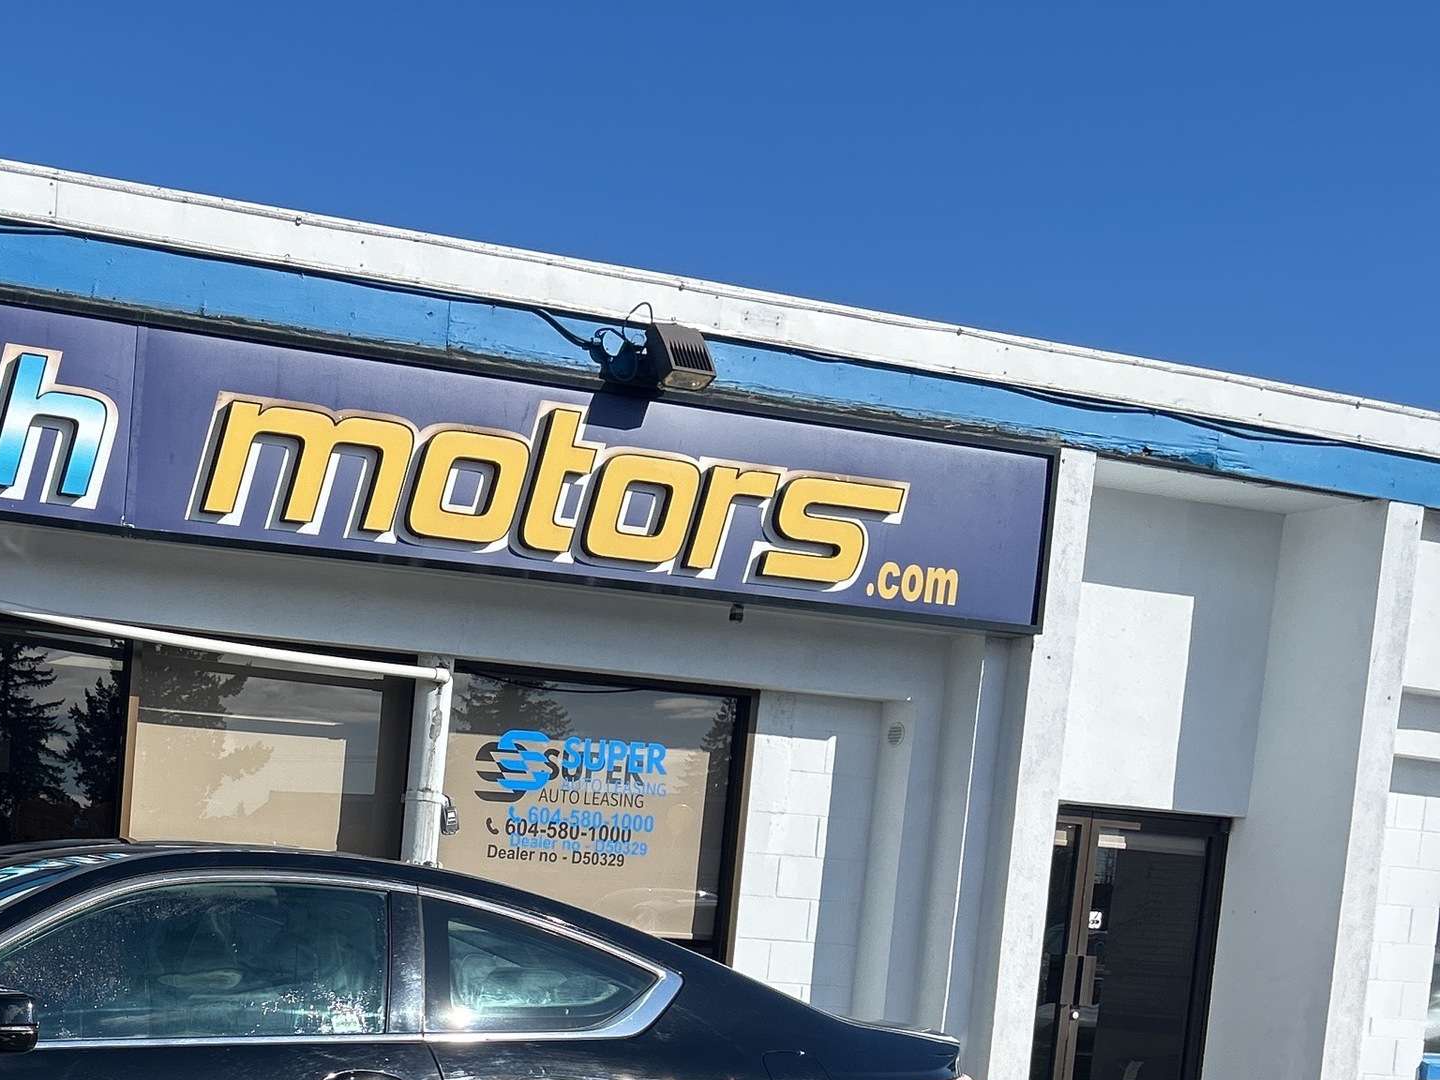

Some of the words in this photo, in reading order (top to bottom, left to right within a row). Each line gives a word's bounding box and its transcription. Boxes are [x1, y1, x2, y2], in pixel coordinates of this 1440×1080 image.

[185, 390, 911, 592] motors
[562, 737, 667, 774] SUPER
[539, 788, 579, 804] AUTO
[583, 791, 644, 809] LEASING
[505, 818, 632, 842] 604-580-1000
[487, 845, 535, 861] Dealer
[539, 851, 557, 862] no
[572, 851, 624, 867] D50329
